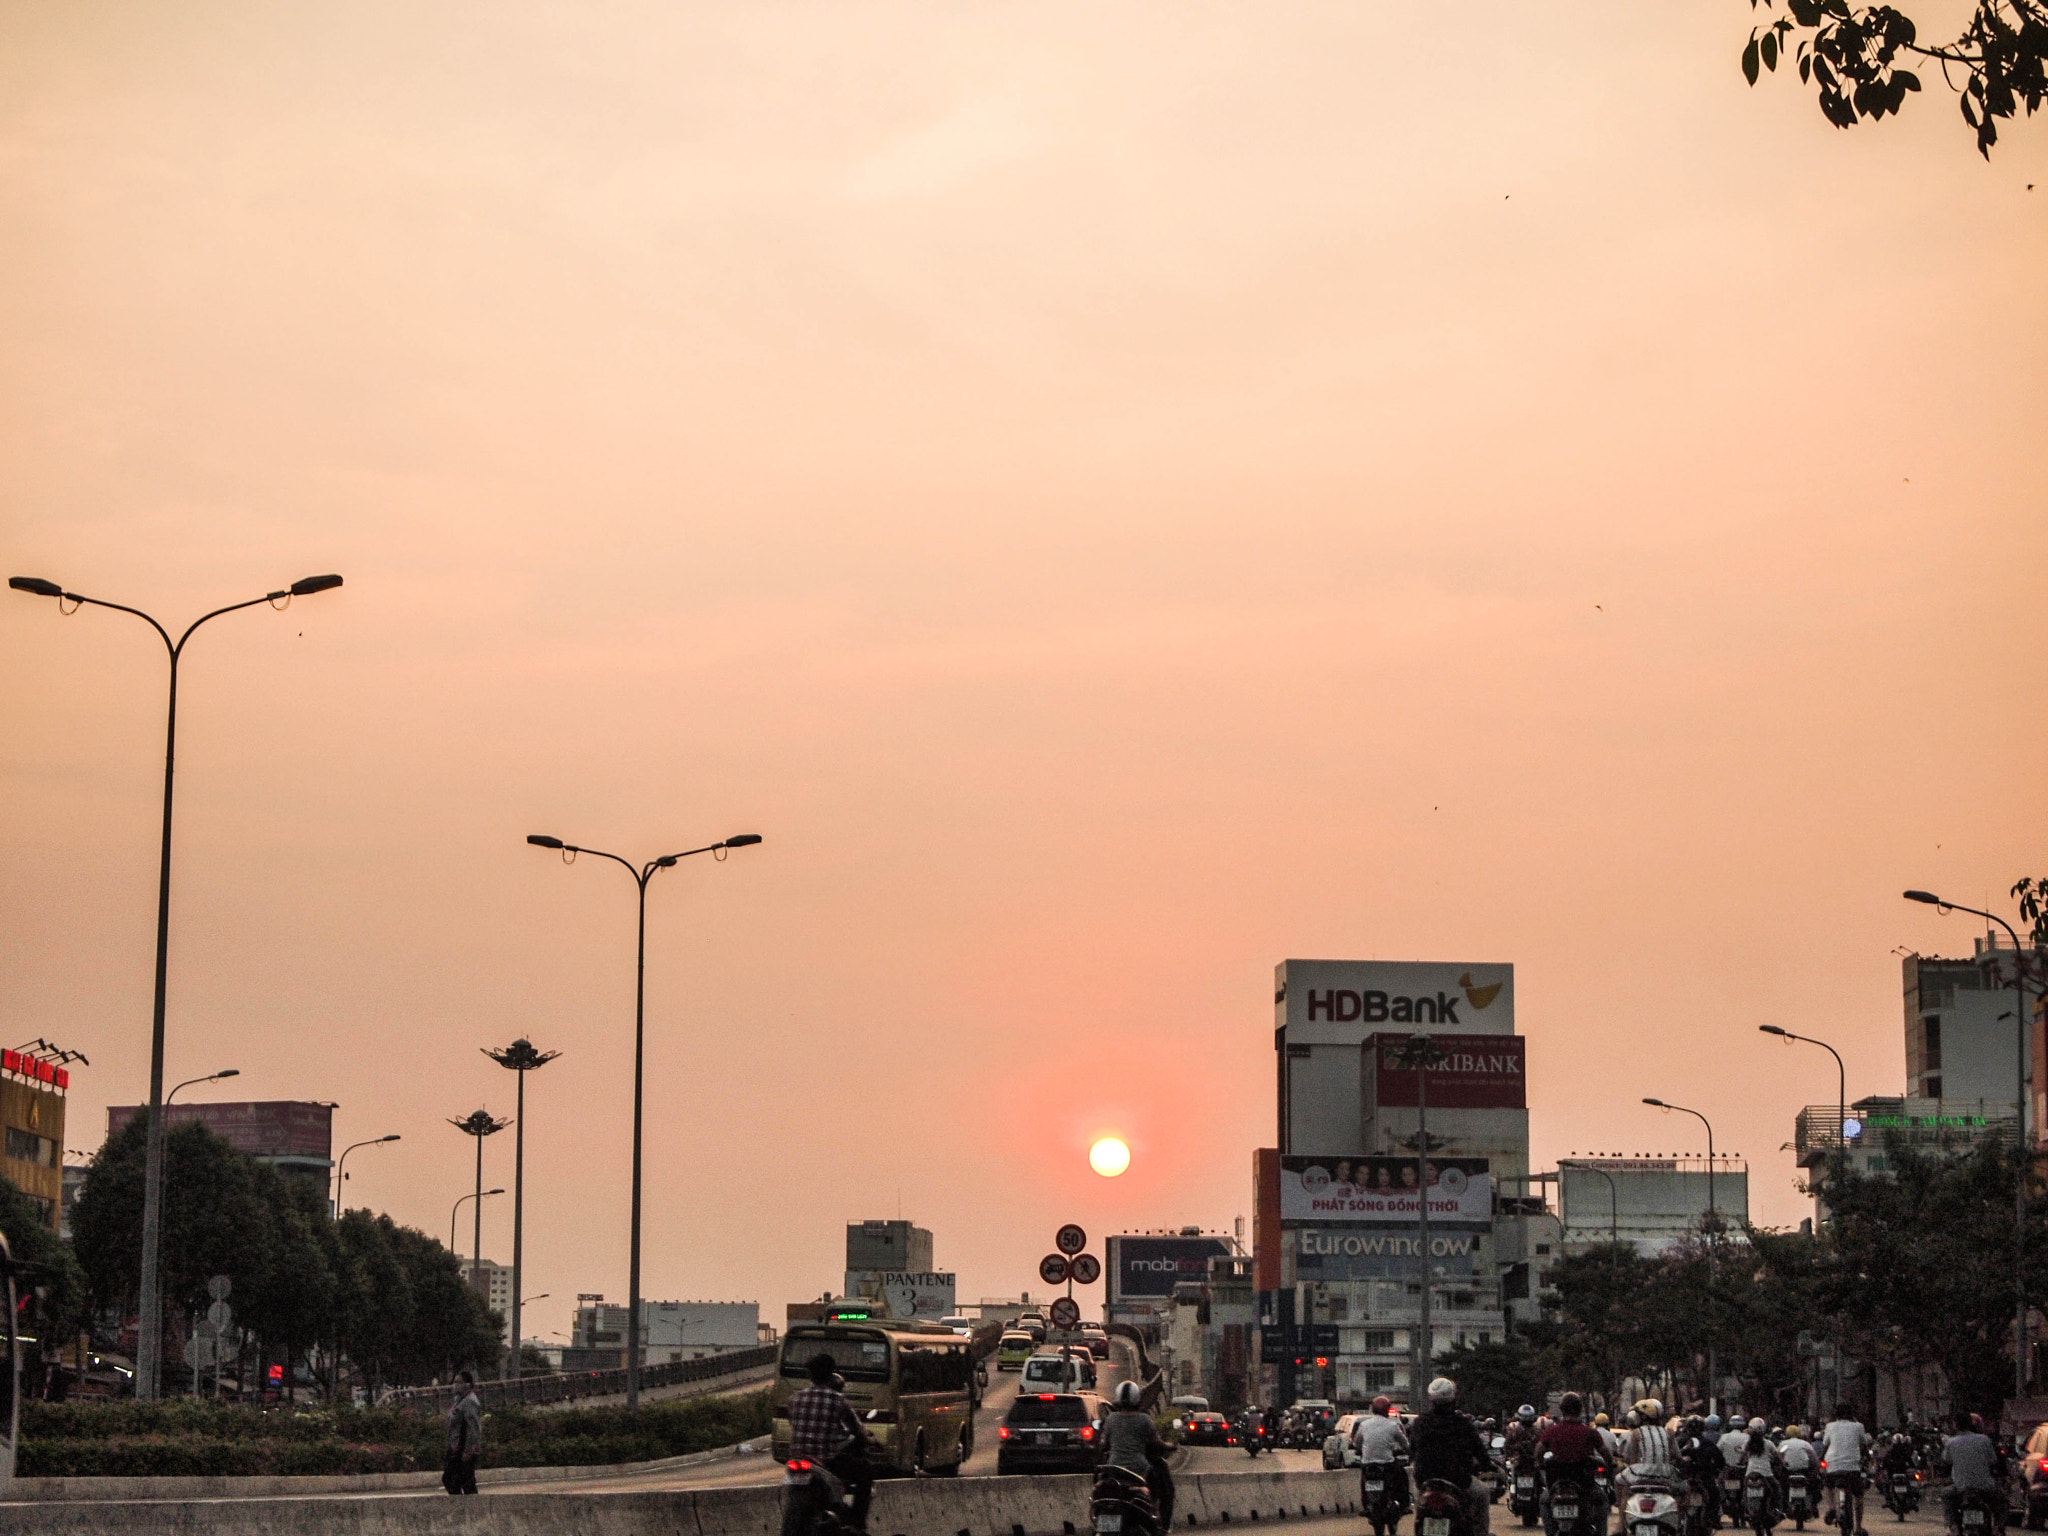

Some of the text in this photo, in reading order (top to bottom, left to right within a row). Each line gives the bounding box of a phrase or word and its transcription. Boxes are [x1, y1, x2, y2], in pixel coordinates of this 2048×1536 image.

[1308, 988, 1460, 1024] HDBank
[1312, 1197, 1346, 1211] PHÁT
[1348, 1197, 1385, 1212] SÓNG
[1063, 1232, 1079, 1247] 50
[886, 1273, 955, 1286] PANTENE
[900, 1288, 917, 1317] 3
